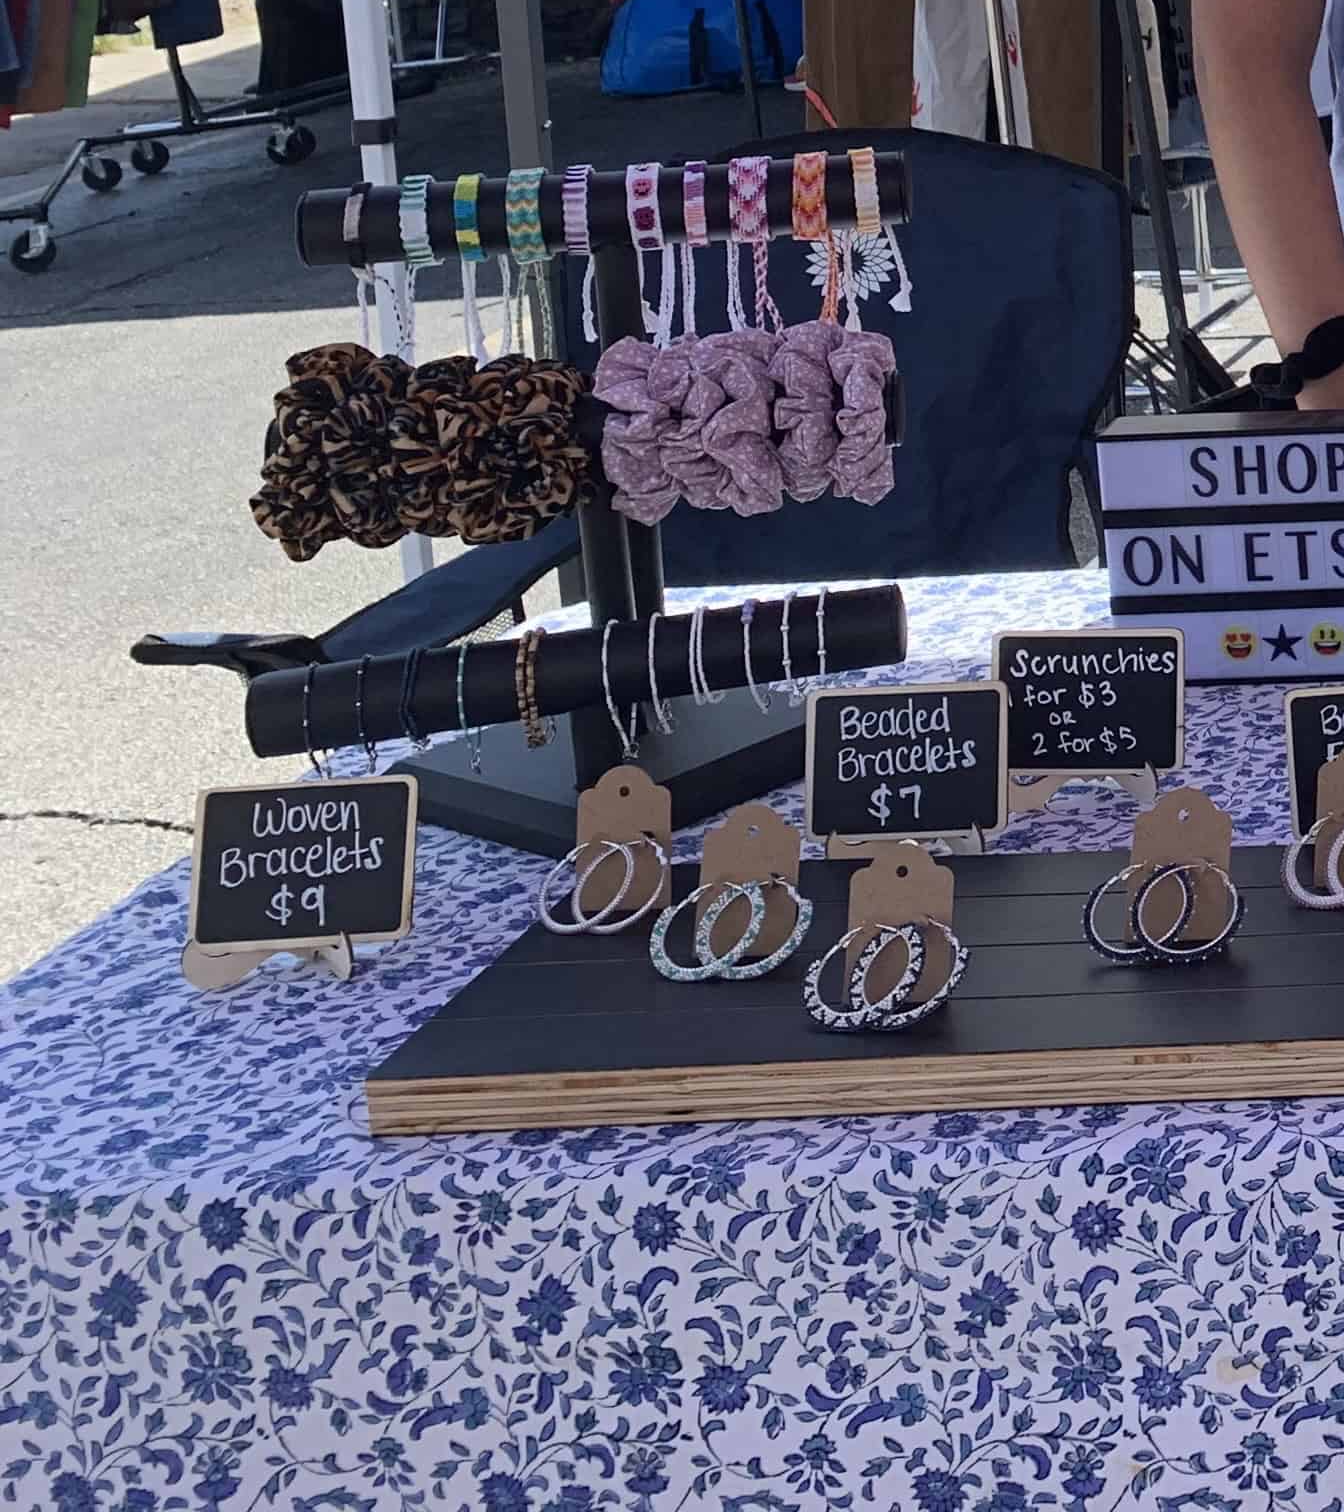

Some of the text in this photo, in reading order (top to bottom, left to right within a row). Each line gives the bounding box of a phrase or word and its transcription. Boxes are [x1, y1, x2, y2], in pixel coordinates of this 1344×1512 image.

[1123, 535, 1205, 587] ON
[1009, 647, 1176, 679] Scrunchies
[1023, 682, 1068, 708] for
[1078, 681, 1118, 709] $3
[839, 696, 952, 740] Beaded
[1048, 710, 1077, 726] OR
[837, 737, 978, 782] Bracelets
[1031, 726, 1138, 756] 2 for $5
[252, 797, 361, 838] Woven
[867, 782, 922, 826] $7
[219, 831, 384, 888] Bracelets
[264, 883, 326, 927] $9
